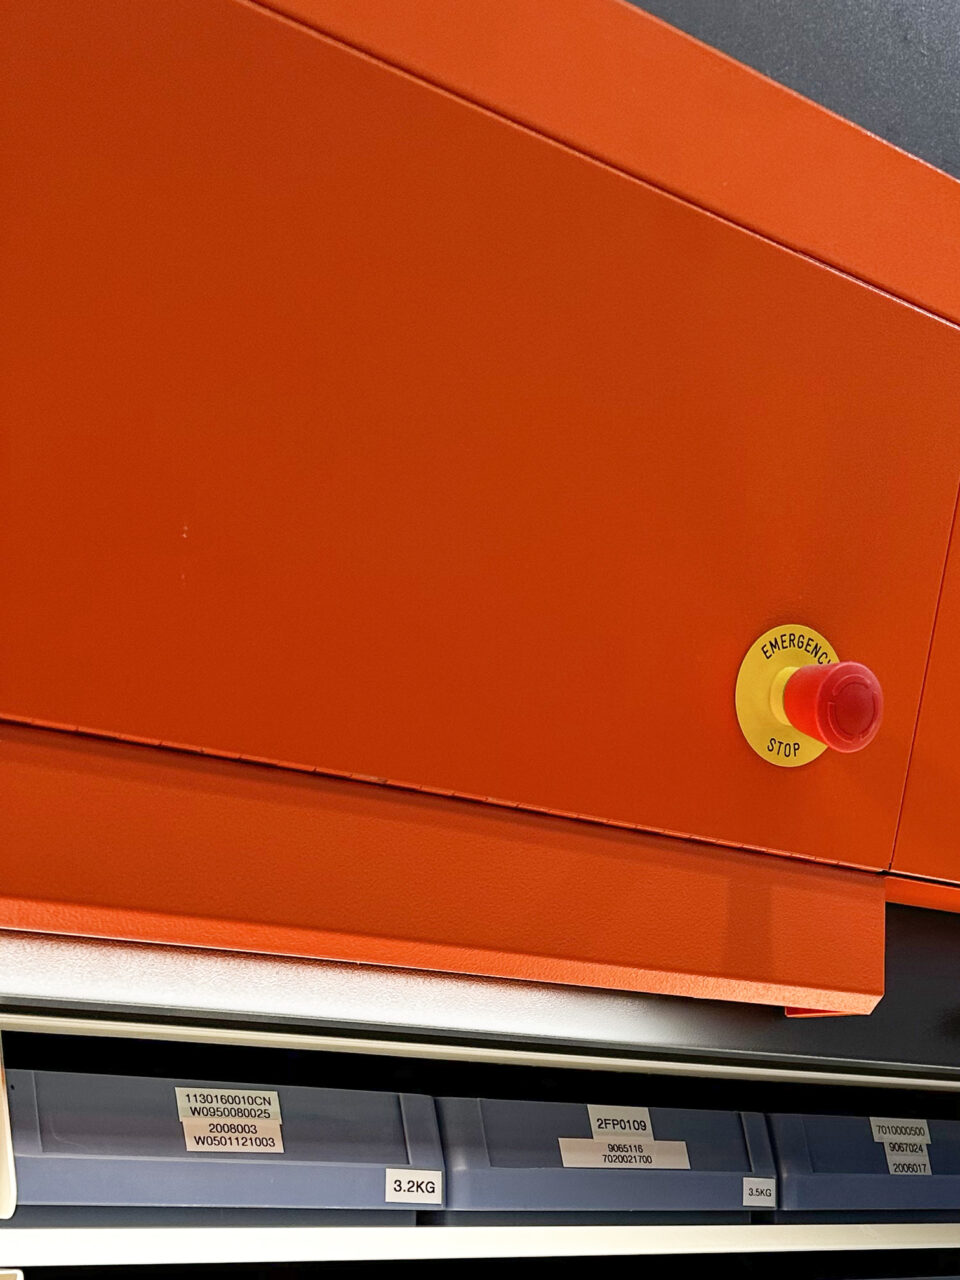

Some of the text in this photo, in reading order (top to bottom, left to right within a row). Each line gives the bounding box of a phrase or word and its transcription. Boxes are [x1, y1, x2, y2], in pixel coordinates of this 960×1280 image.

[761, 633, 832, 665] EMERGENC
[767, 738, 801, 758] STOP
[185, 1093, 272, 1107] 1130160010CN
[189, 1106, 271, 1119] W0950080025
[208, 1123, 258, 1135] 2008003
[596, 1118, 647, 1132] 2FP0109
[876, 1124, 925, 1137] 7010000500
[193, 1135, 276, 1148] W0501121003
[888, 1142, 924, 1153] 9067024
[607, 1143, 644, 1154] 9065116
[602, 1154, 653, 1165] 7020021700
[892, 1163, 927, 1174] 2006017
[393, 1179, 436, 1195] 3.2KG
[748, 1187, 772, 1198] 3.5KG
